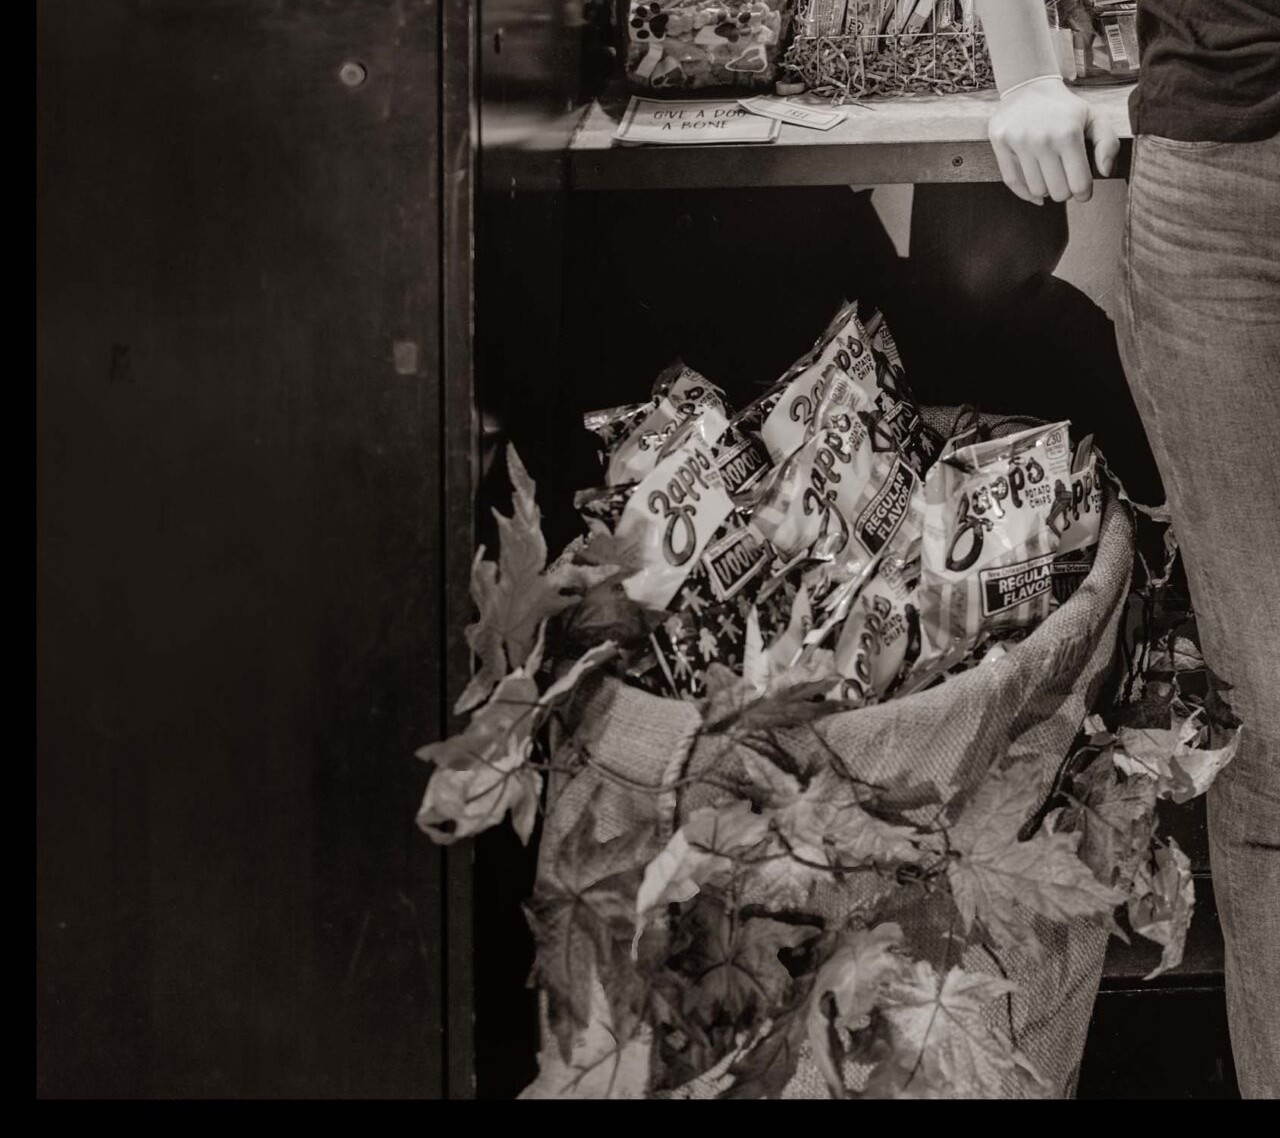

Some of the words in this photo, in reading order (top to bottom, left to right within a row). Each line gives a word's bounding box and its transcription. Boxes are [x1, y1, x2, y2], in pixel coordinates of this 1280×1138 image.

[653, 110, 688, 120] GIVE
[696, 110, 705, 119] A
[713, 109, 748, 119] DOG
[662, 121, 672, 131] A
[681, 120, 728, 130] BONE
[851, 352, 874, 373] POTATO
[856, 362, 875, 381] CHIPS
[1024, 483, 1052, 500] POTATO
[863, 471, 906, 537] REGULAR
[1028, 495, 1053, 510] CHIPS
[876, 485, 911, 542] FLAVOR
